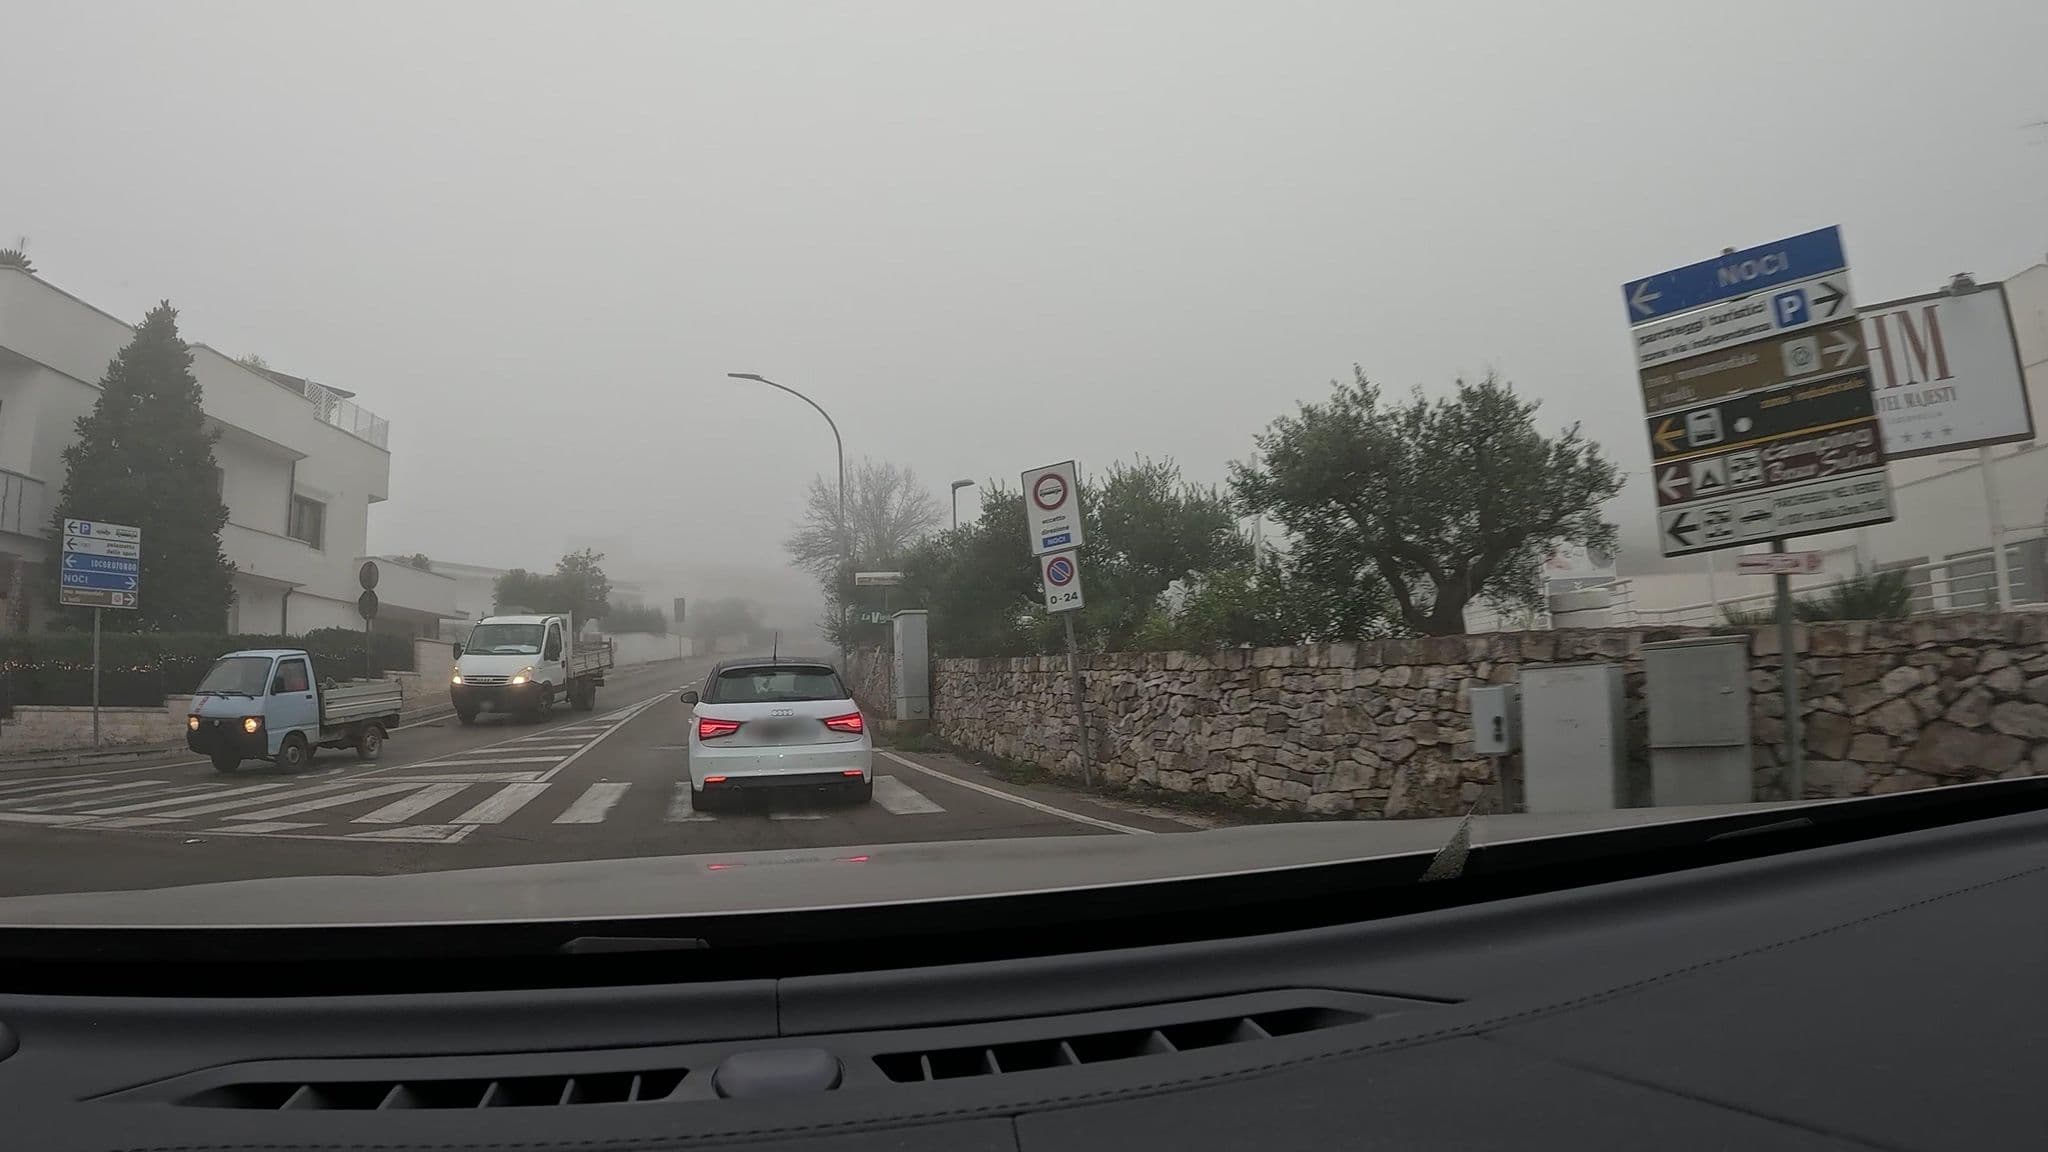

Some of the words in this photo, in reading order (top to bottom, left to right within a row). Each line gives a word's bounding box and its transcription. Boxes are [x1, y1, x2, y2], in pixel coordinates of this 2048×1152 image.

[1717, 251, 1789, 287] NOCI
[1639, 316, 1705, 346] parcheggi
[1781, 294, 1803, 324] P
[1904, 386, 1958, 409] MAJESTY
[1763, 428, 1874, 462] camping
[1042, 515, 1066, 525] eccetto
[1041, 525, 1070, 536] direzione
[1047, 535, 1067, 546] NOCI
[64, 573, 88, 584] NOCI
